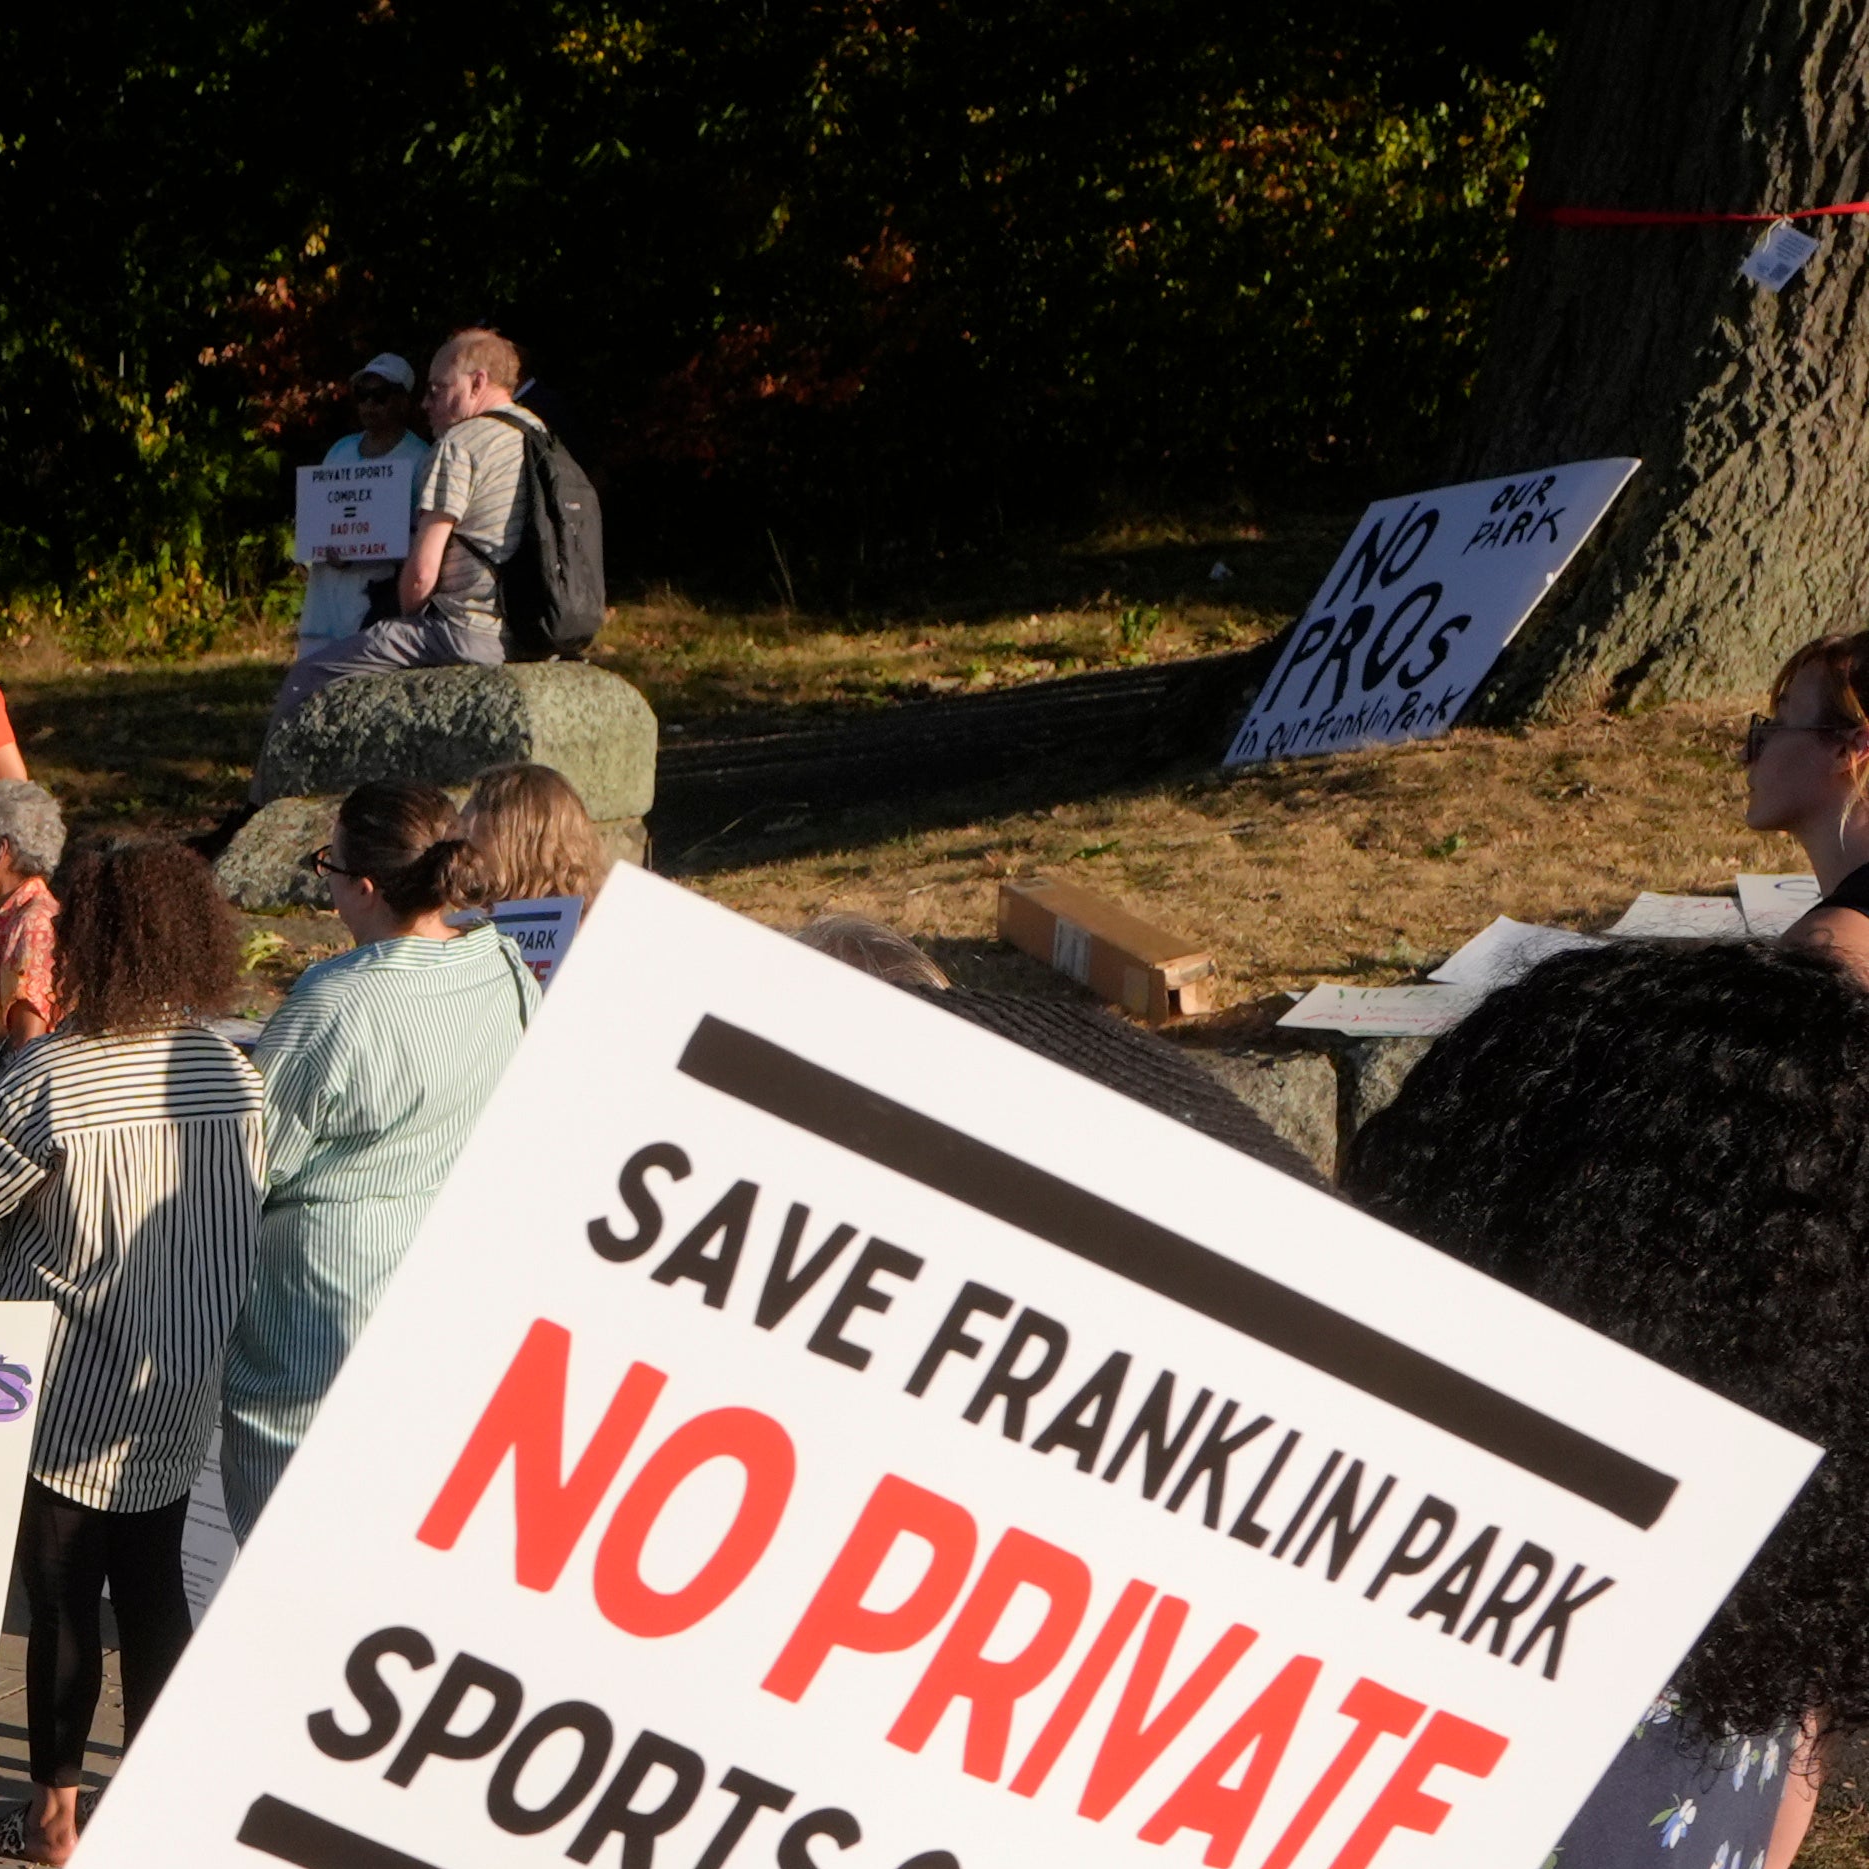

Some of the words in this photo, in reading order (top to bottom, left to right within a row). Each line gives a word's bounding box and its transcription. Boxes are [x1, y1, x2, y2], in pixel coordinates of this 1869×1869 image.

[312, 467, 350, 482] PRIVATE
[355, 465, 393, 479] SPORTS
[1490, 475, 1556, 513] OUR
[328, 489, 372, 503] COMPLEX
[360, 543, 387, 555] PARK
[1462, 507, 1566, 556] PARK
[1325, 502, 1439, 608] NO
[588, 1141, 925, 1370] SAVE
[904, 1282, 1367, 1583] FRANKLIN
[1367, 1496, 1614, 1680] PARK
[416, 1317, 796, 1638] NO
